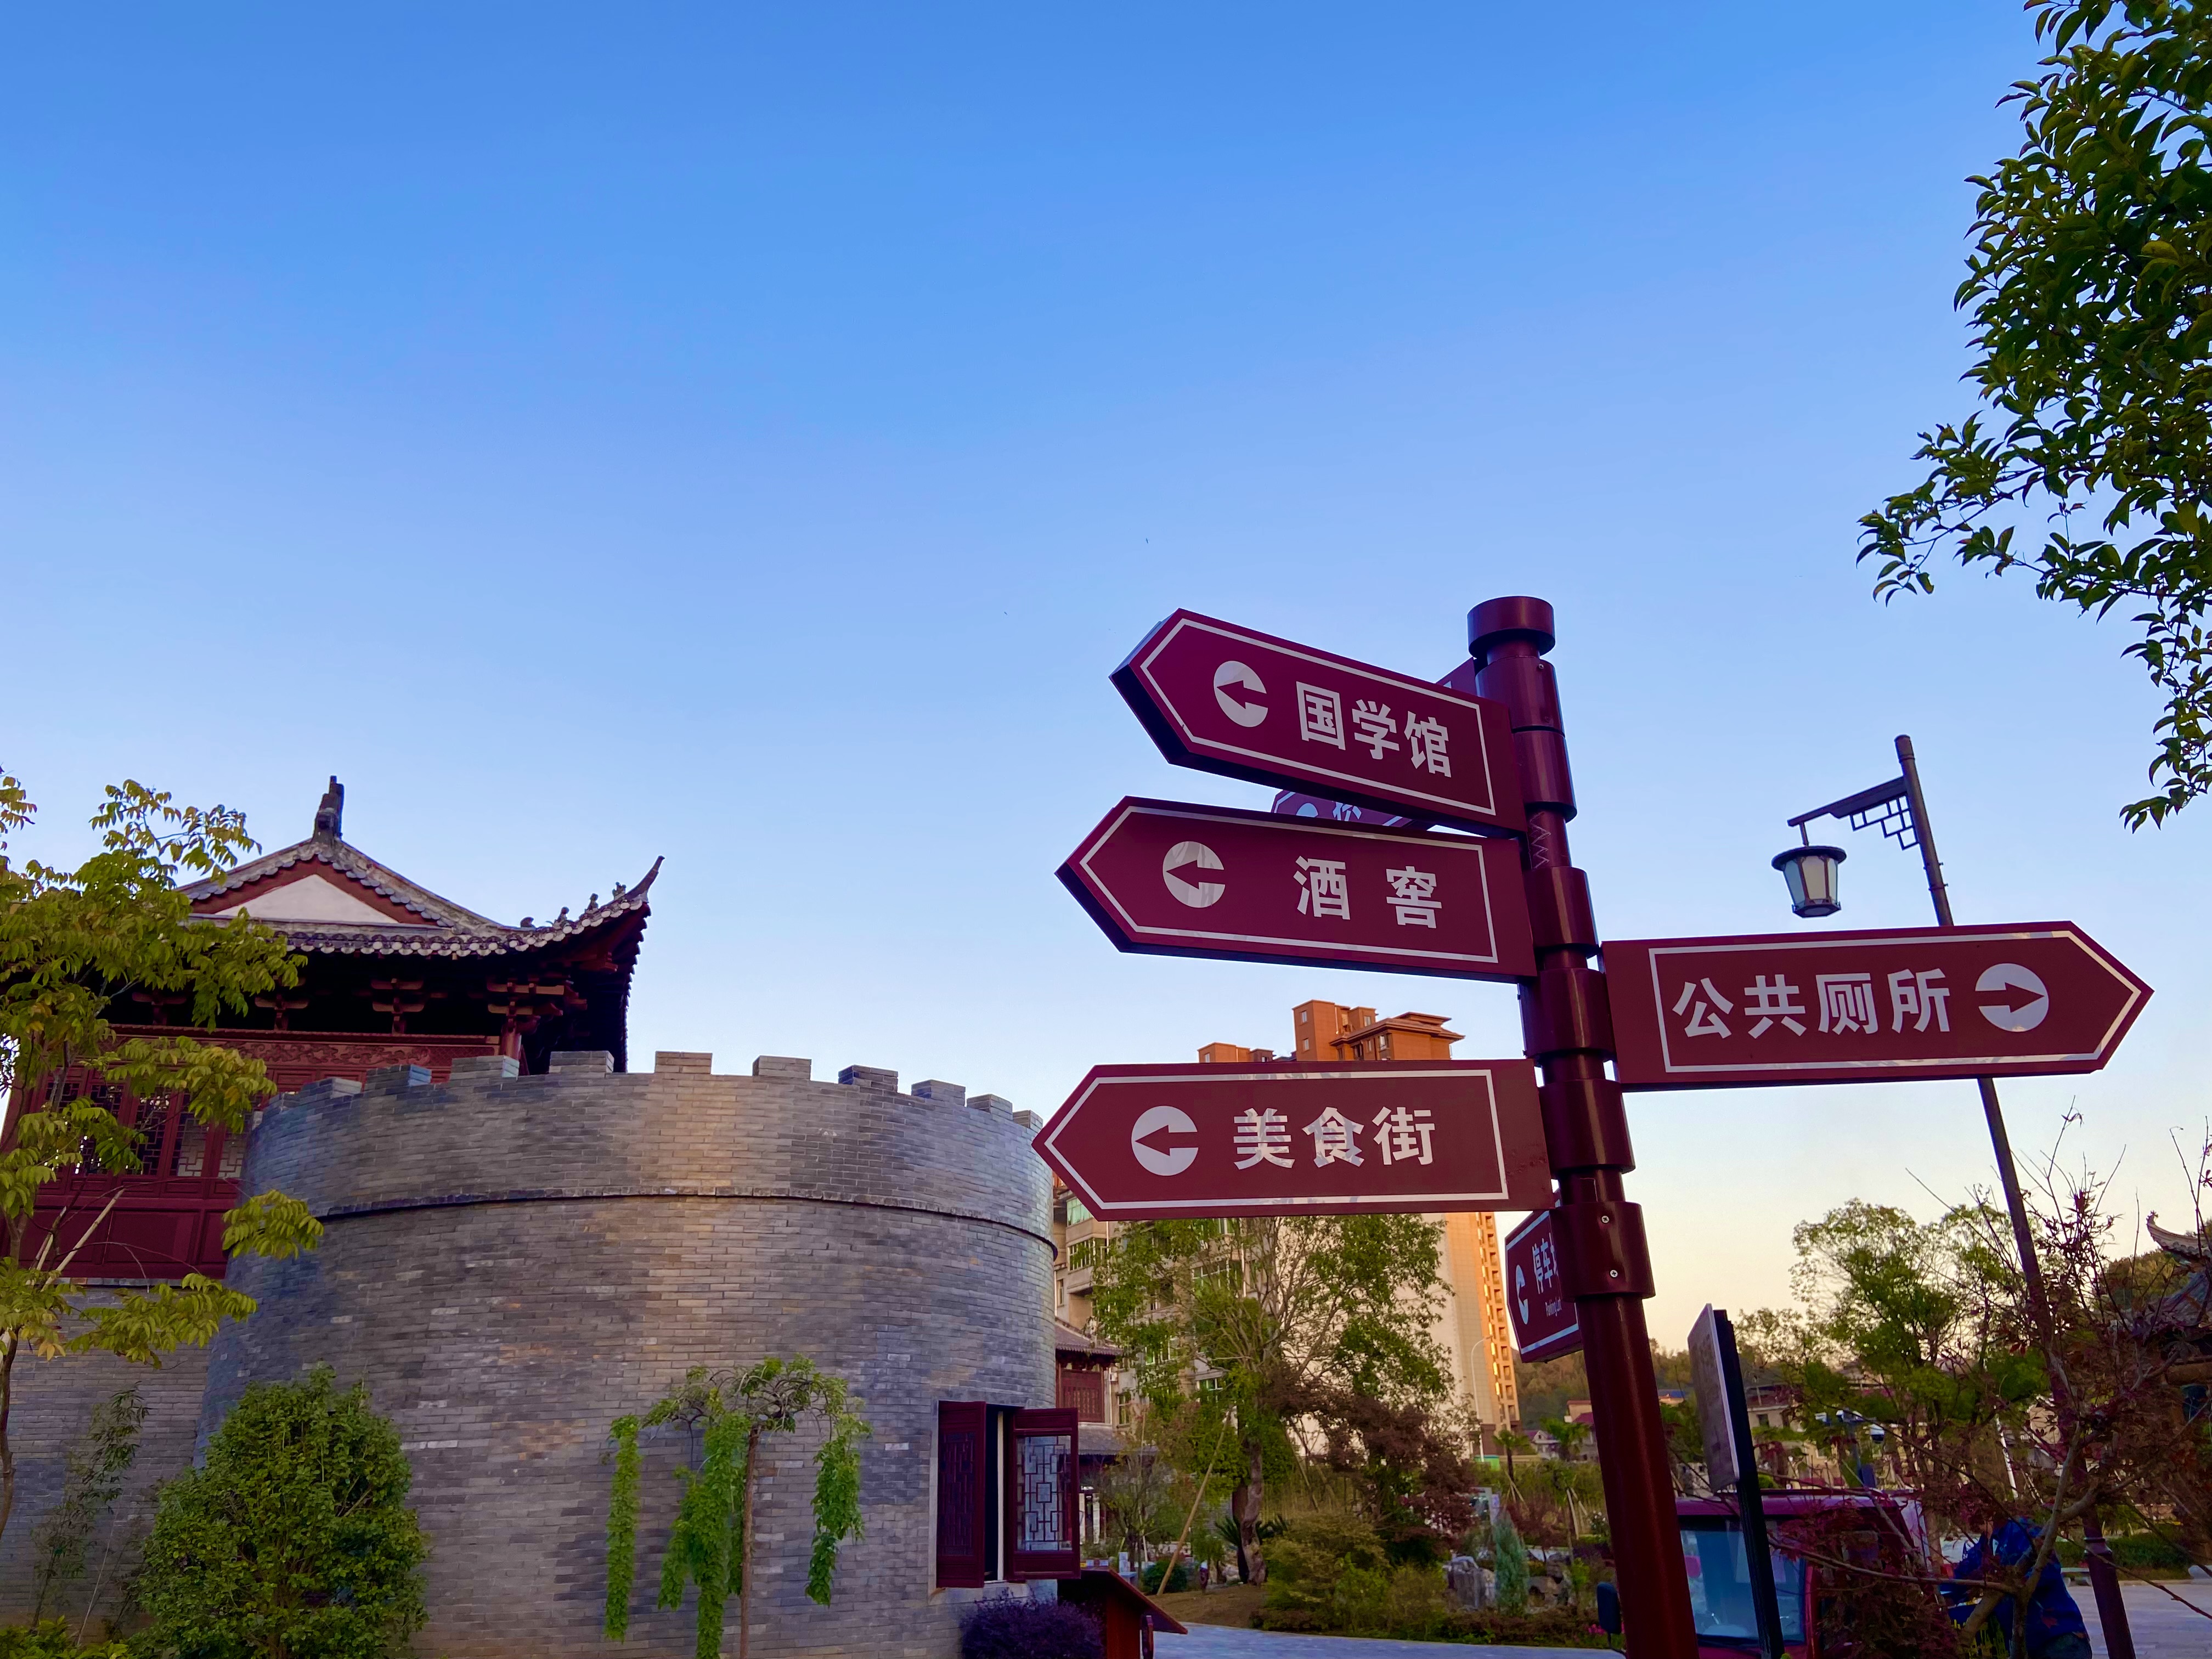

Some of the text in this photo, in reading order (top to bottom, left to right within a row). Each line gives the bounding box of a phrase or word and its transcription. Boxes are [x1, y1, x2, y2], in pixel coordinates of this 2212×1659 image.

[1296, 681, 1452, 778] 国学馆
[1294, 856, 1442, 929] 酒窖
[1673, 969, 1950, 1039] 公共厕所
[1233, 1106, 1435, 1170] 美食街
